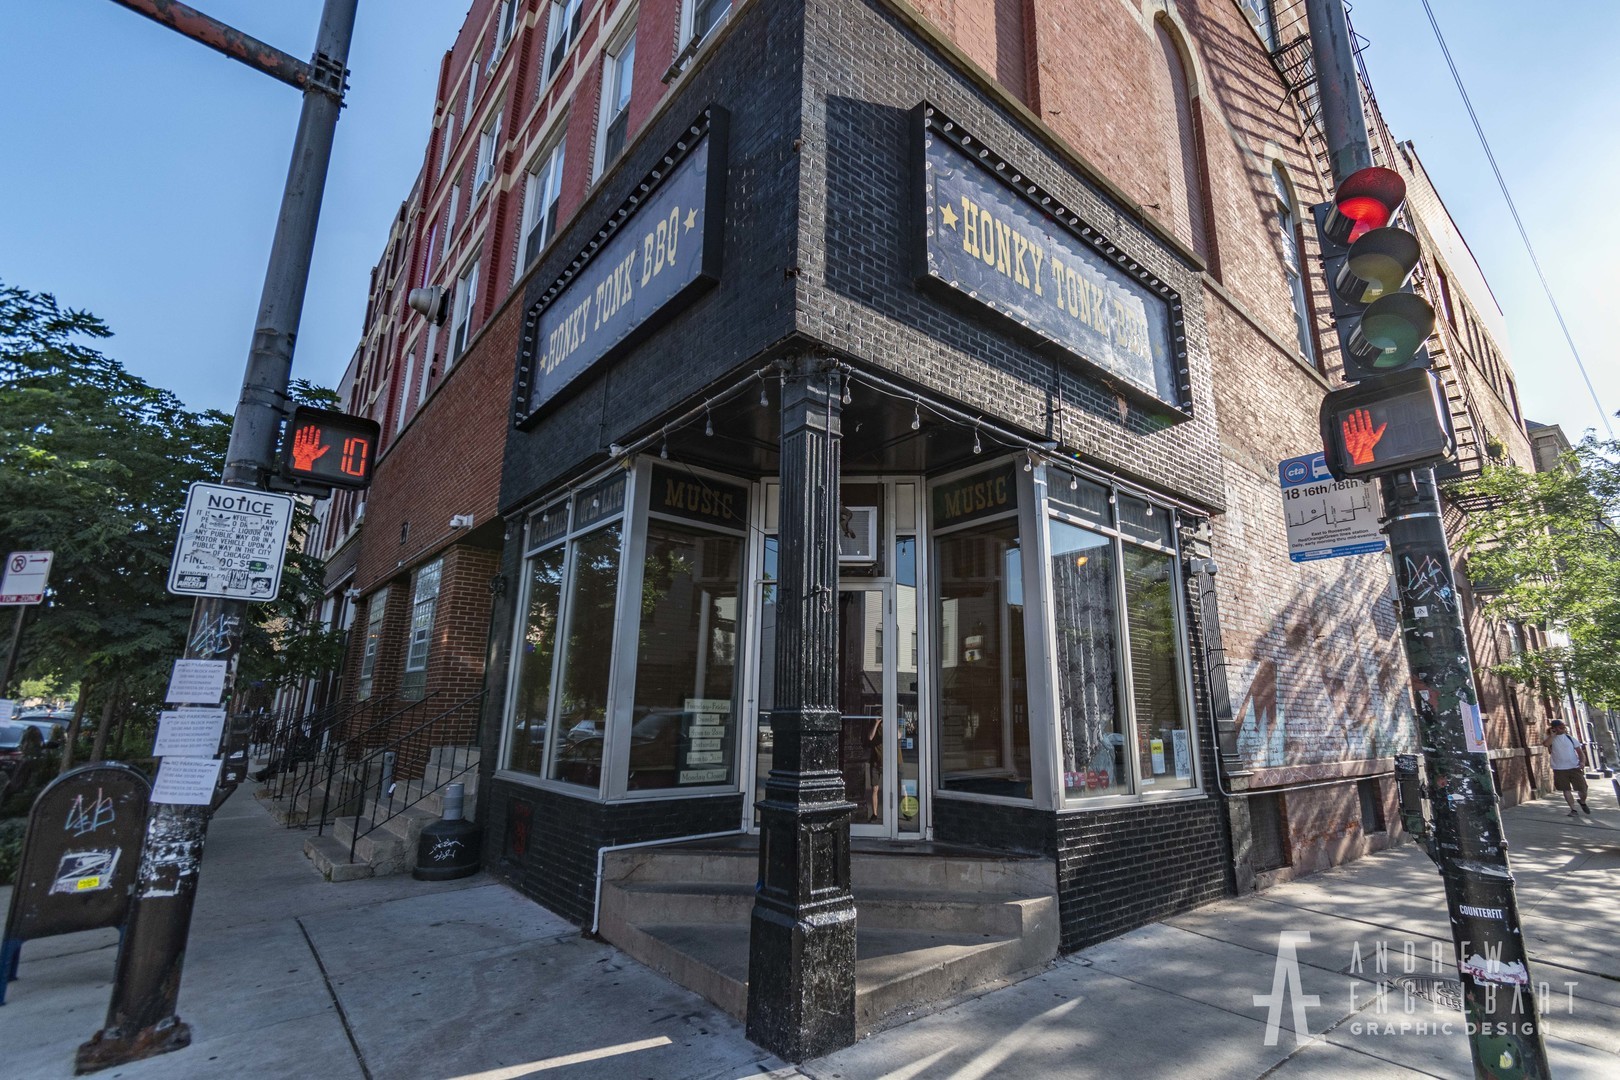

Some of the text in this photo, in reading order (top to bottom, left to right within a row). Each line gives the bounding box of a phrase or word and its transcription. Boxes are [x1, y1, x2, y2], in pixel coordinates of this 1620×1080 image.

[962, 196, 1044, 296] HONKY
[1051, 258, 1106, 336] TONK
[546, 206, 679, 376] HONKY TONK BBQ
[341, 437, 368, 477] 10
[1288, 467, 1304, 477] cta
[665, 478, 734, 520] MUSIC
[944, 476, 1007, 519] MUSIC
[1284, 480, 1358, 500] 18 16th/18th
[208, 494, 274, 515] NOTICE
[195, 534, 217, 543] MOTOR
[220, 538, 244, 546] VEHICLE
[210, 530, 232, 538] PUBLIC
[191, 540, 215, 549] PUBLIC
[223, 551, 250, 560] CHICAGO
[1459, 904, 1502, 919] COUNTERFIT
